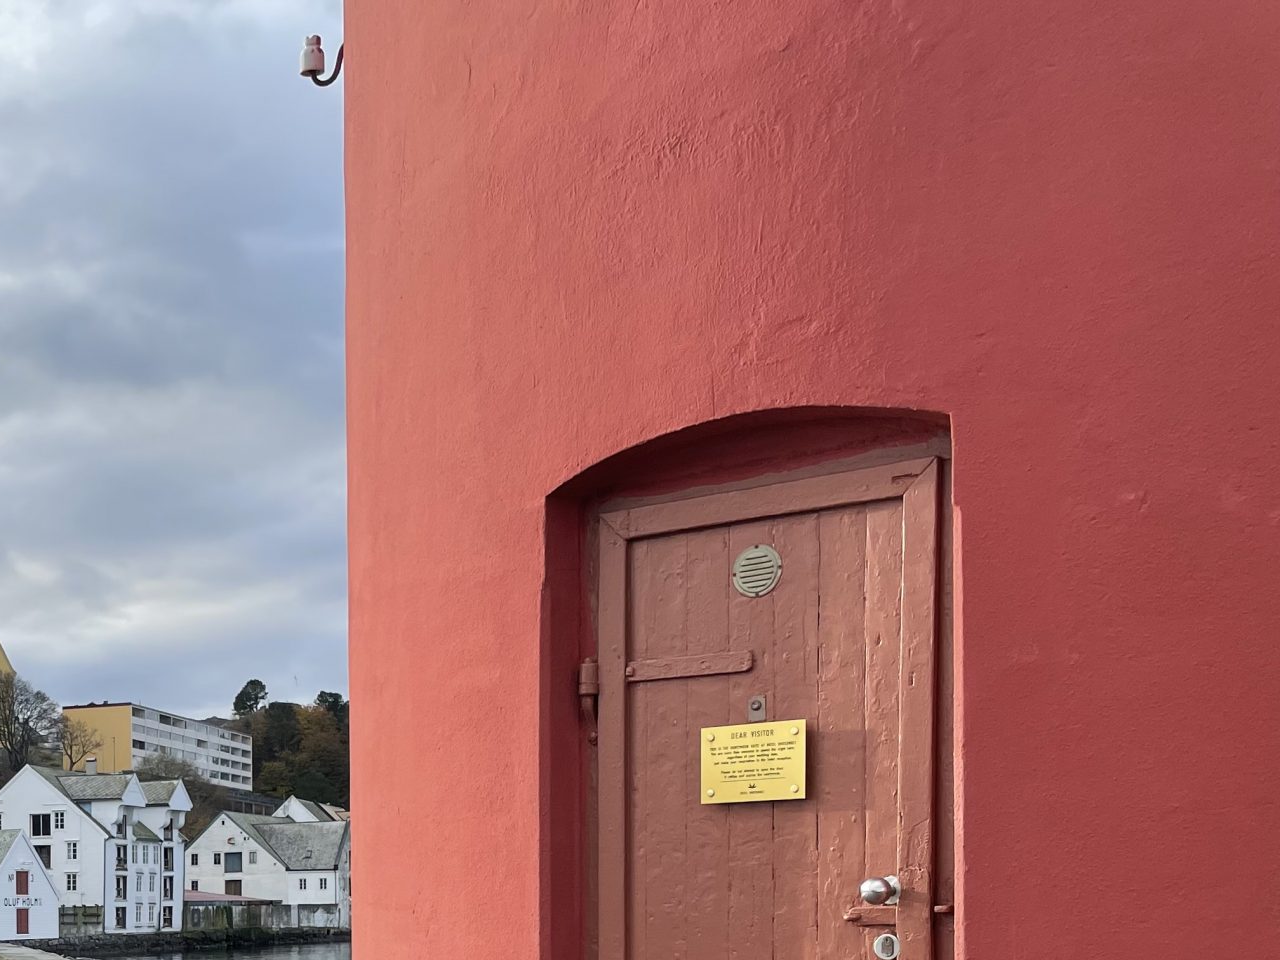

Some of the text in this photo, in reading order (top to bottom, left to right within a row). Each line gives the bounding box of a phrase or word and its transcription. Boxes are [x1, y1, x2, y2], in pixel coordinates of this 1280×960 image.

[731, 729, 774, 739] DEAR VISITOR
[4, 898, 20, 906] OLUF
[22, 898, 38, 906] HOLM
